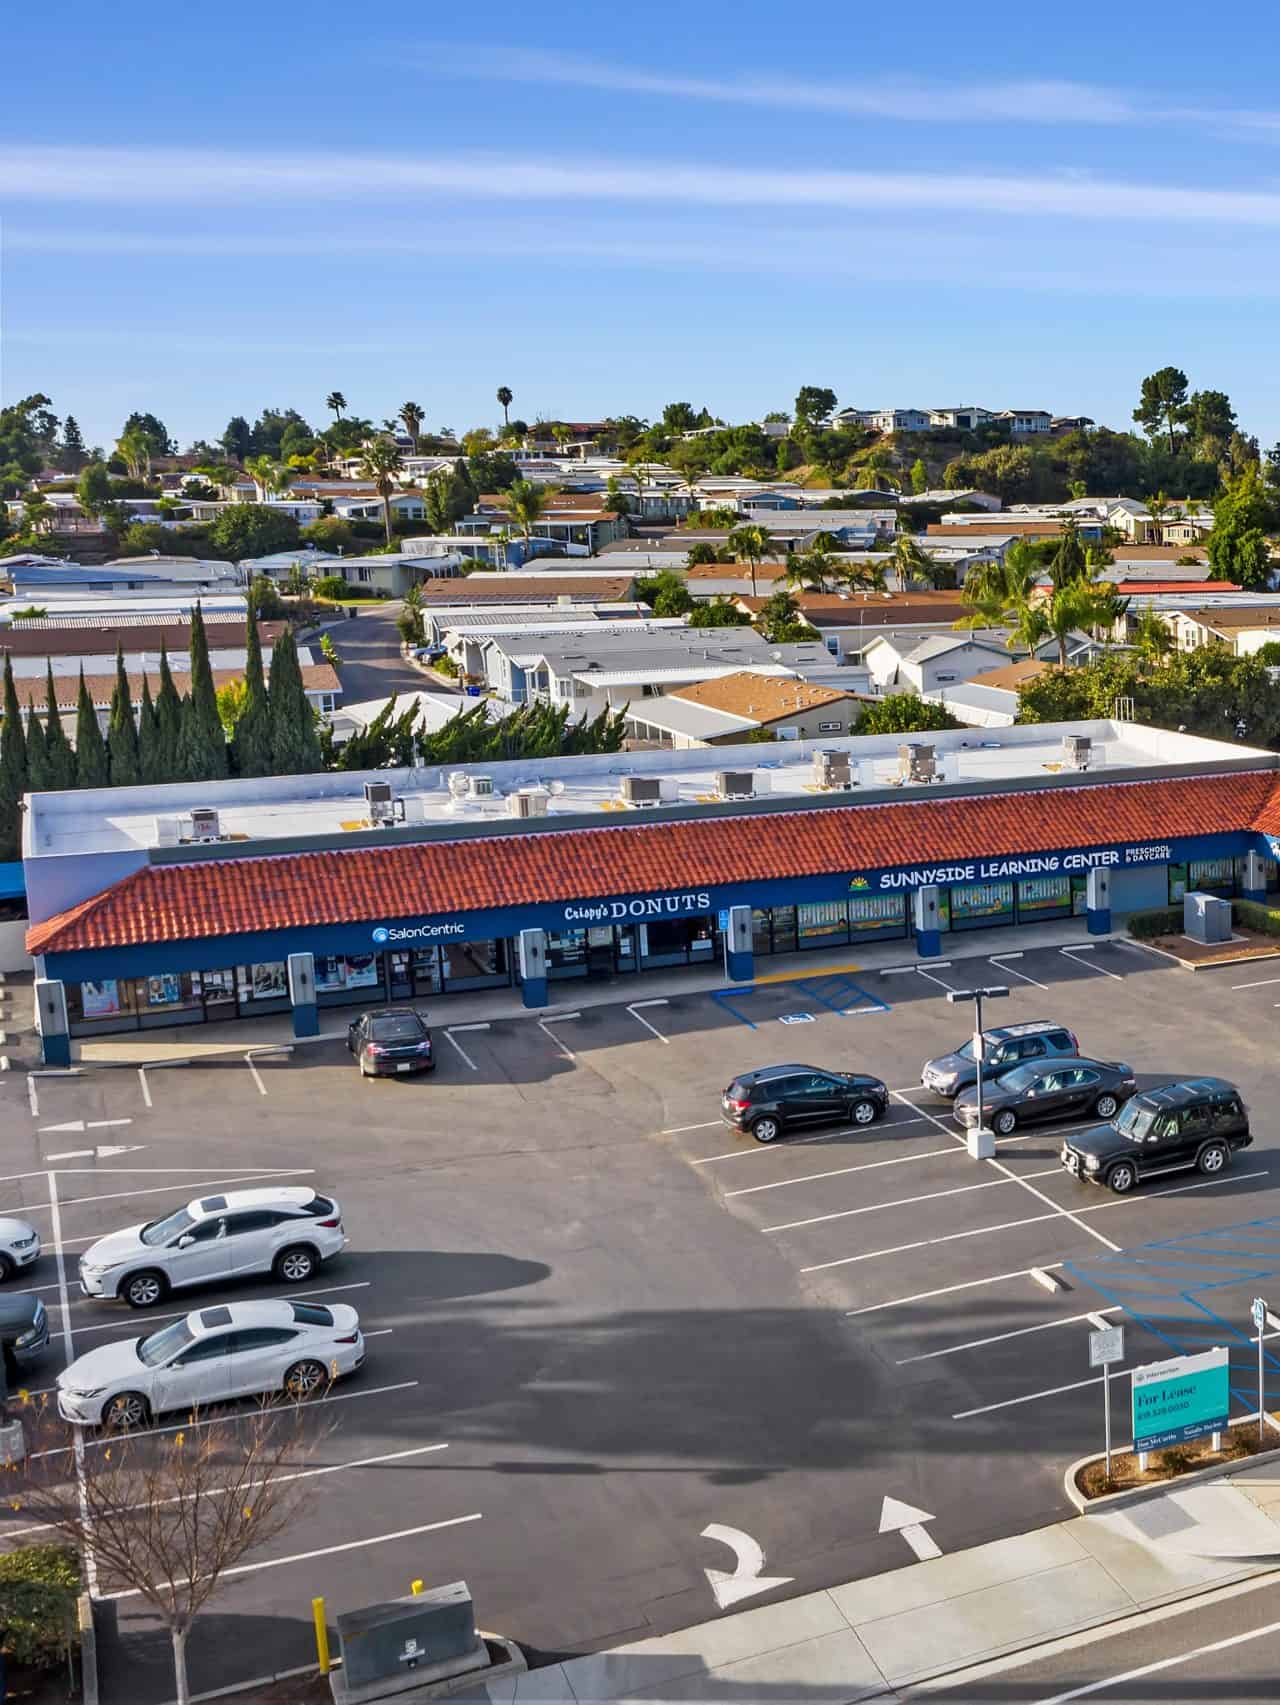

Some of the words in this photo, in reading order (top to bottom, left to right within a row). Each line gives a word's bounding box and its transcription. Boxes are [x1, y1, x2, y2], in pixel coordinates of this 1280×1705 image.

[1125, 846, 1169, 856] PRESCHOOL
[1133, 852, 1171, 862] DAYCARE
[880, 866, 975, 889] SUNNYSIDE
[980, 857, 1059, 878] LEARNING
[1063, 851, 1119, 869] CENTER
[564, 904, 609, 921] Crispy's
[610, 893, 710, 918] DONUTS
[389, 922, 465, 941] SalonCentric
[1138, 1395, 1159, 1408] For
[1162, 1385, 1197, 1400] Lease
